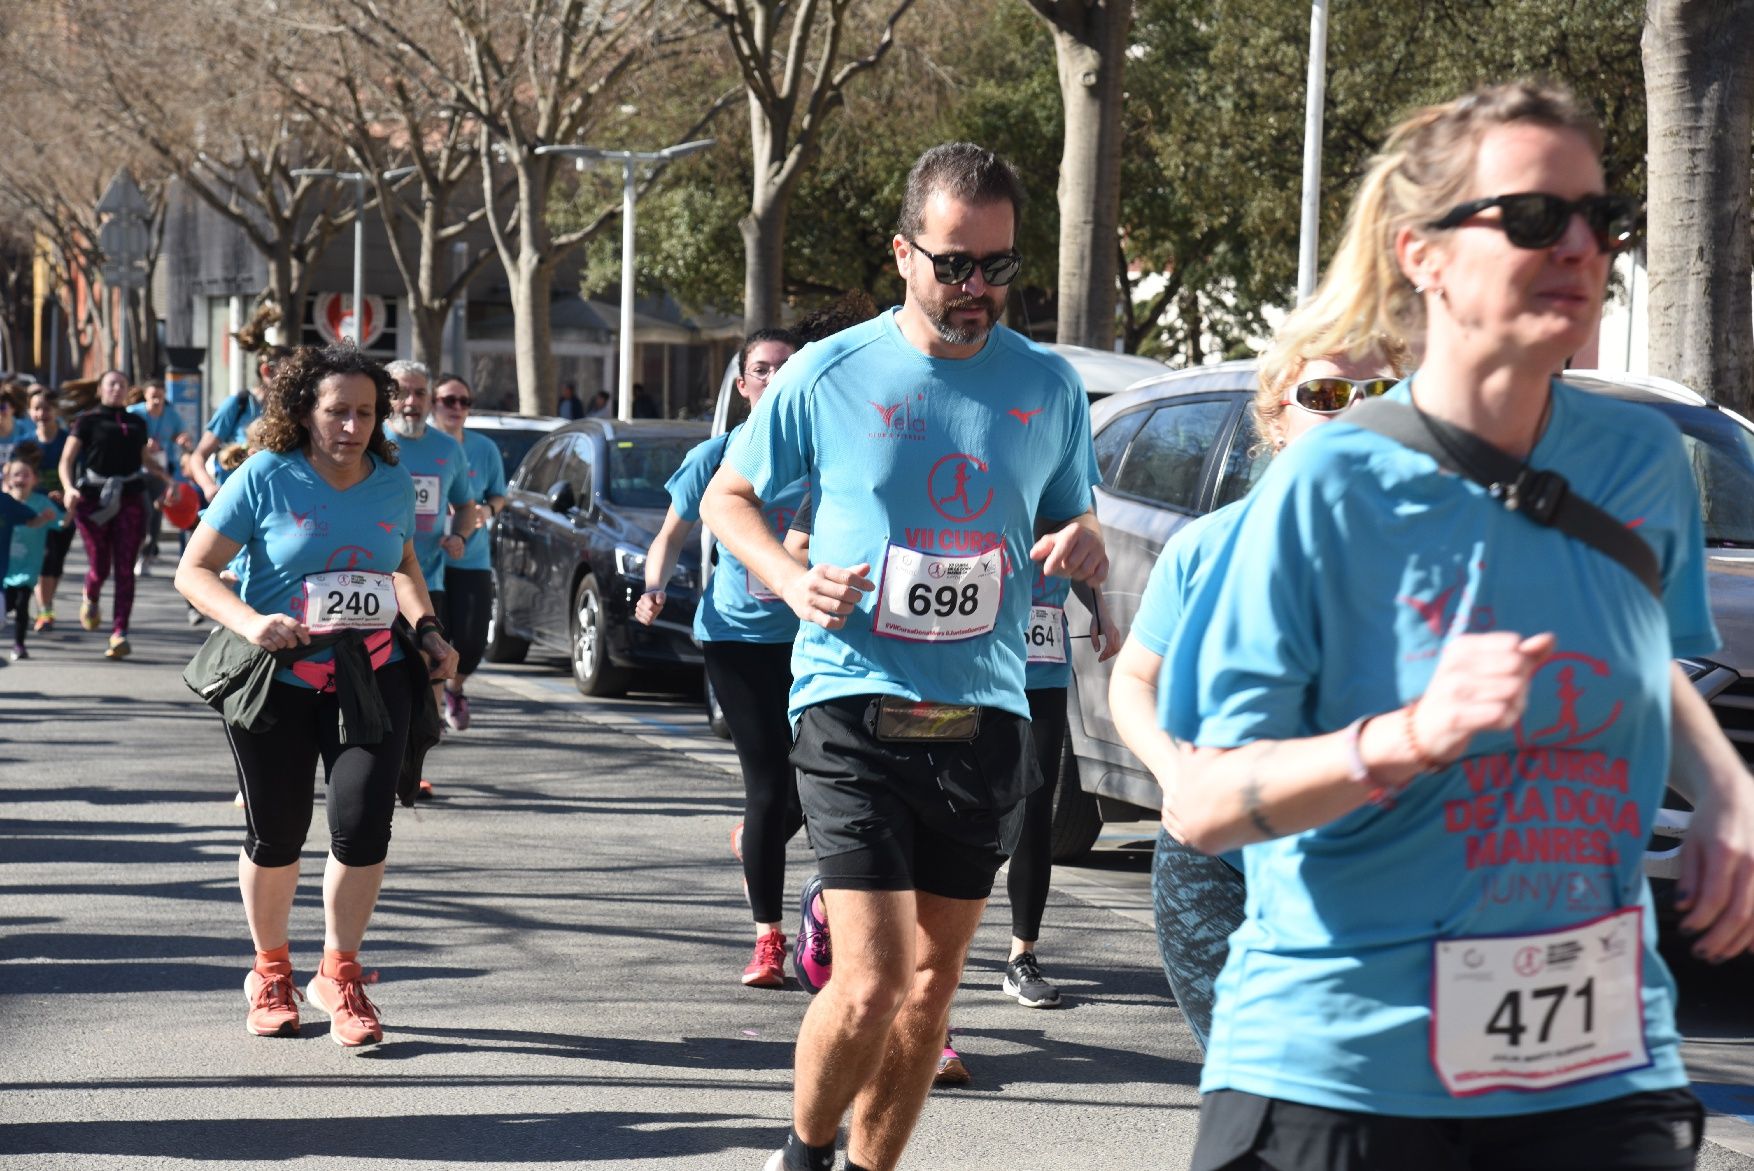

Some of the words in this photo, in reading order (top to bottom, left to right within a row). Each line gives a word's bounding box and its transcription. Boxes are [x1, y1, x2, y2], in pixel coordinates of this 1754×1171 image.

[904, 527, 935, 549] VII
[326, 590, 380, 616] 240
[908, 583, 979, 617] 698
[1462, 753, 1514, 793] VII
[1516, 747, 1631, 794] CURSA
[1443, 794, 1497, 833] DE
[1503, 786, 1549, 823] LA
[1484, 976, 1597, 1047] 471
